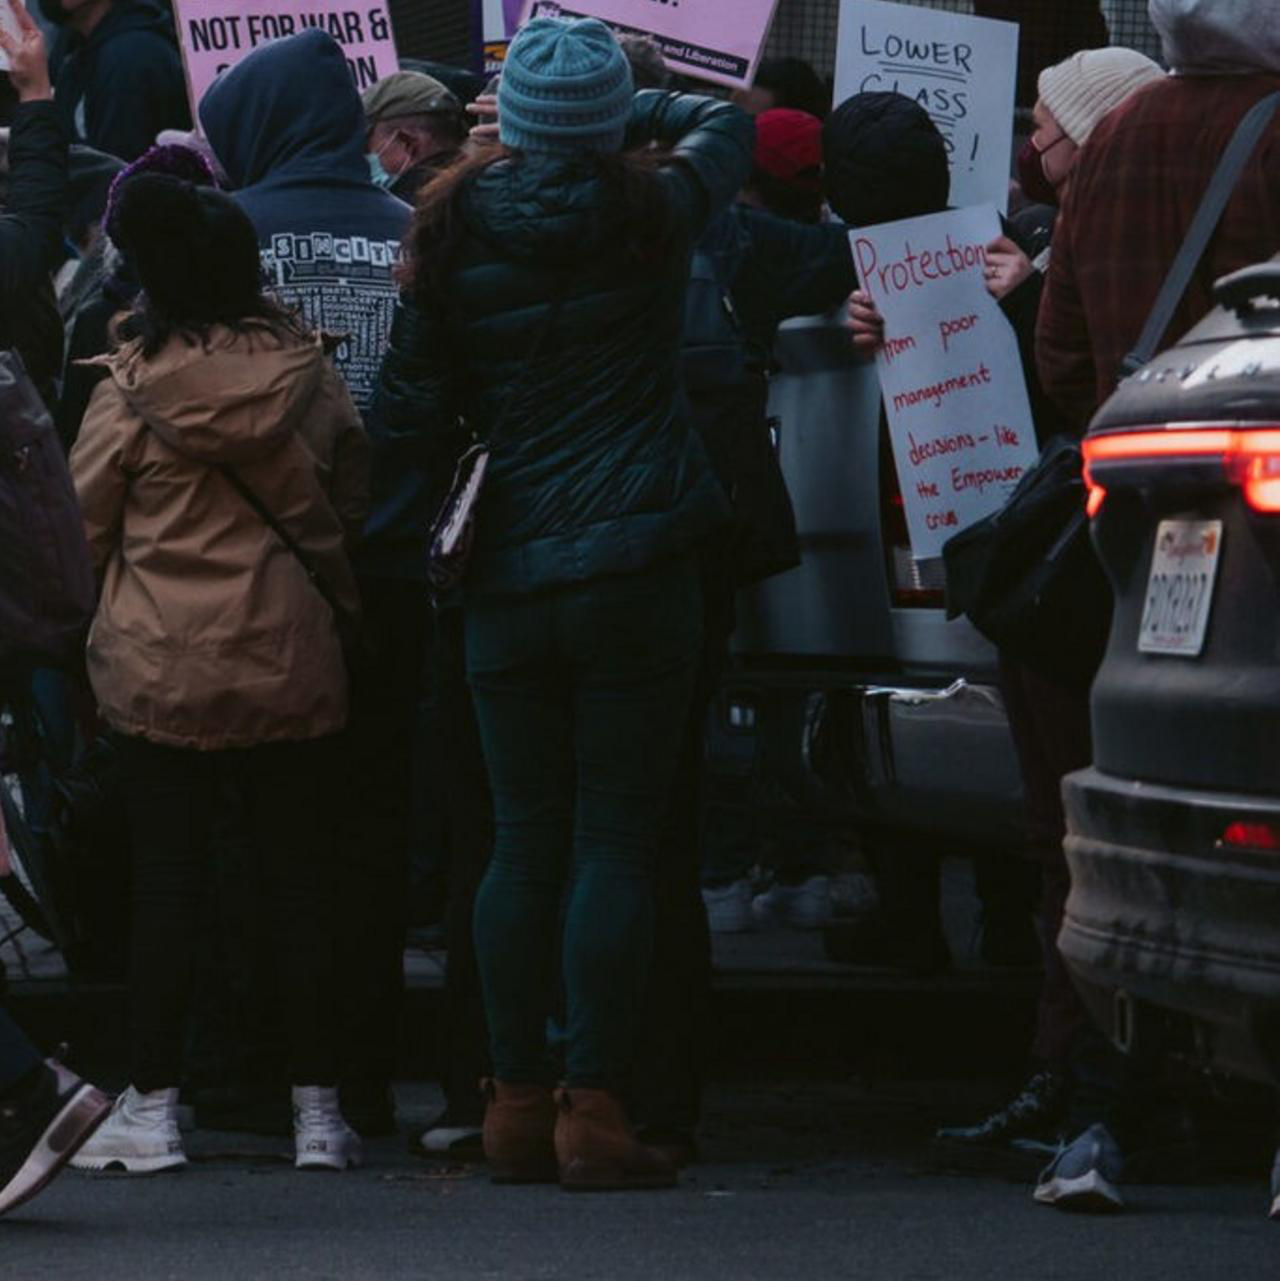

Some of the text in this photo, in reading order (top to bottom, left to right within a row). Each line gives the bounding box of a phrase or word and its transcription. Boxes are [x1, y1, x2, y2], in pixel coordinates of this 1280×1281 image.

[189, 16, 241, 52] NOT
[368, 8, 390, 41] &
[860, 26, 972, 73] LOWER
[855, 234, 986, 302] Protection
[939, 312, 979, 353] poor
[950, 465, 1024, 495] Empower
